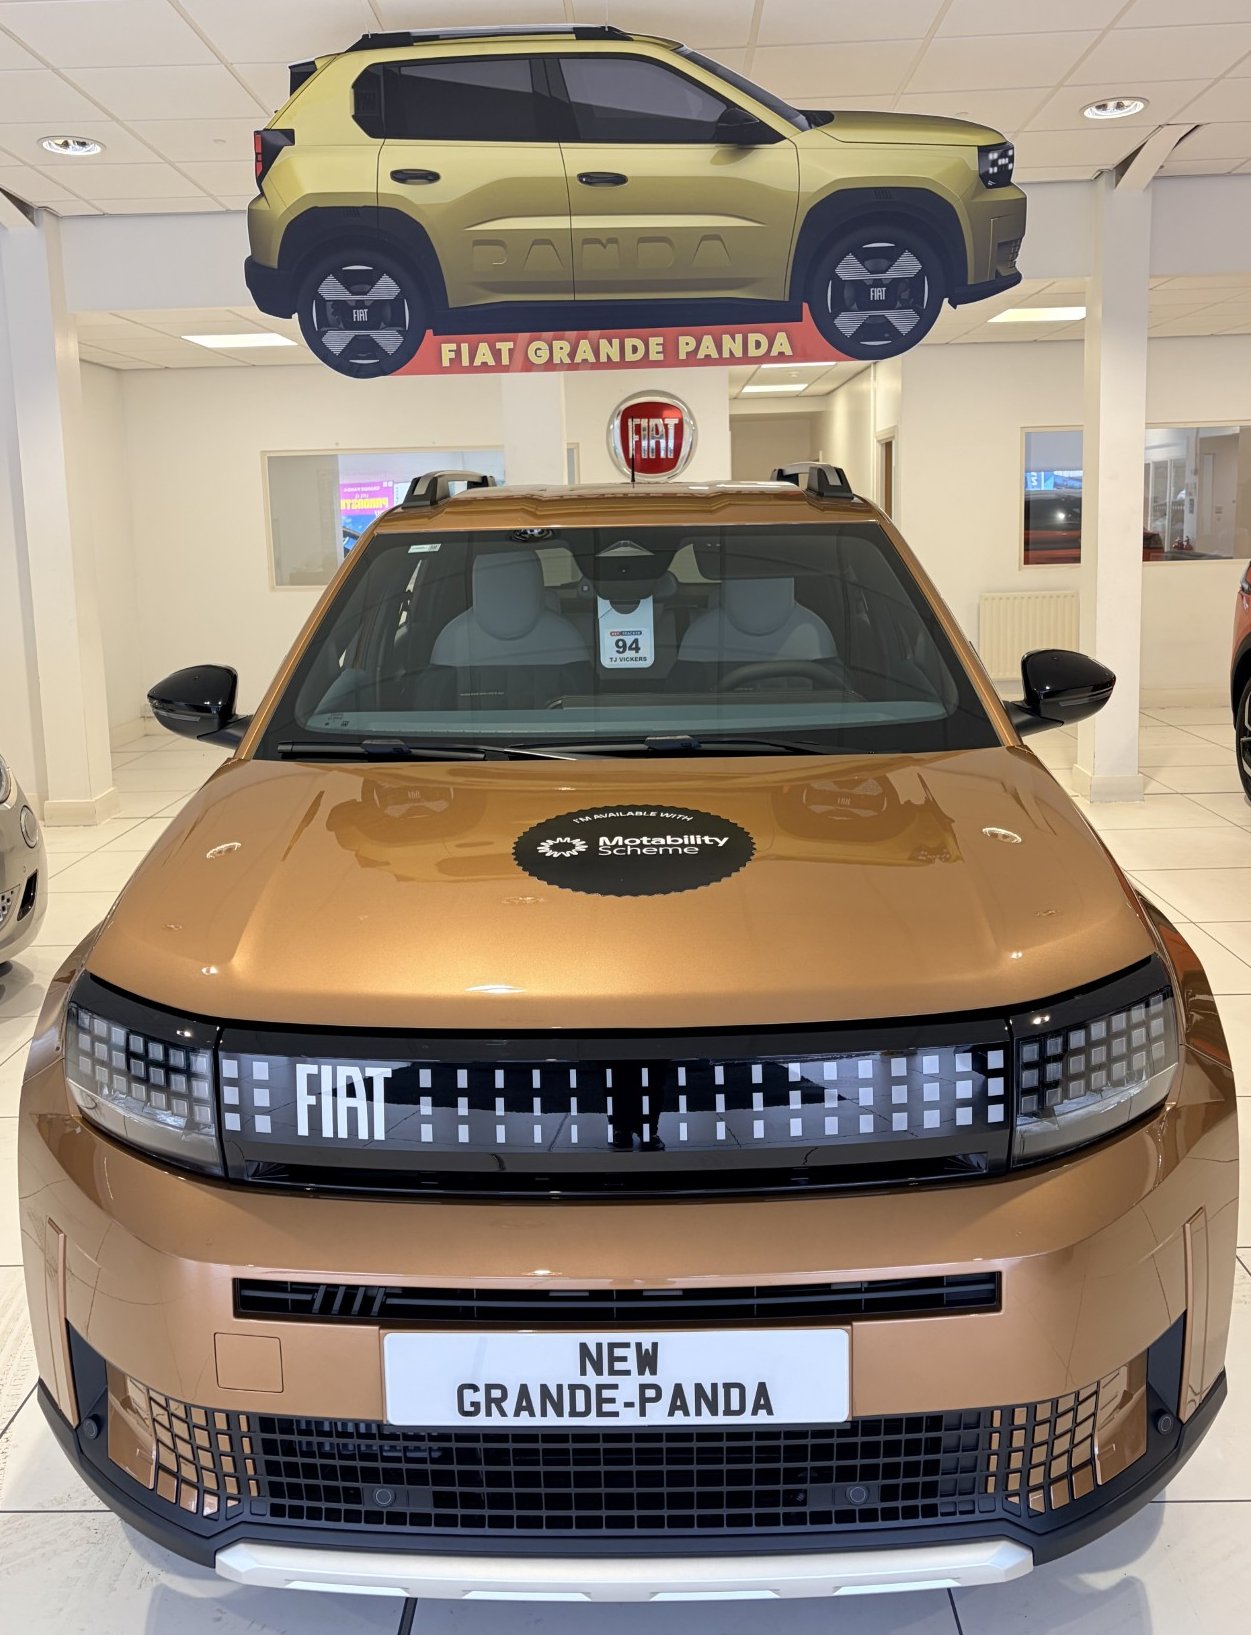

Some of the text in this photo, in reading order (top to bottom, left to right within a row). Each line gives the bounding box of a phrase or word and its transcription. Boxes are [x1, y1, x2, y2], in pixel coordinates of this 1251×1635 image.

[870, 287, 887, 301] FIAT
[352, 308, 369, 322] FIAT
[440, 332, 794, 367] FIAT GRANDE PANDA
[627, 417, 680, 459] FIAT
[614, 638, 641, 654] 94
[573, 811, 694, 824] I'M AVAILABLE WITH
[598, 834, 729, 847] Motability
[598, 845, 700, 856] Scheme
[296, 1063, 393, 1141] FIAT
[579, 1341, 659, 1377] NEW
[456, 1381, 775, 1418] GRANDE-PANDA
